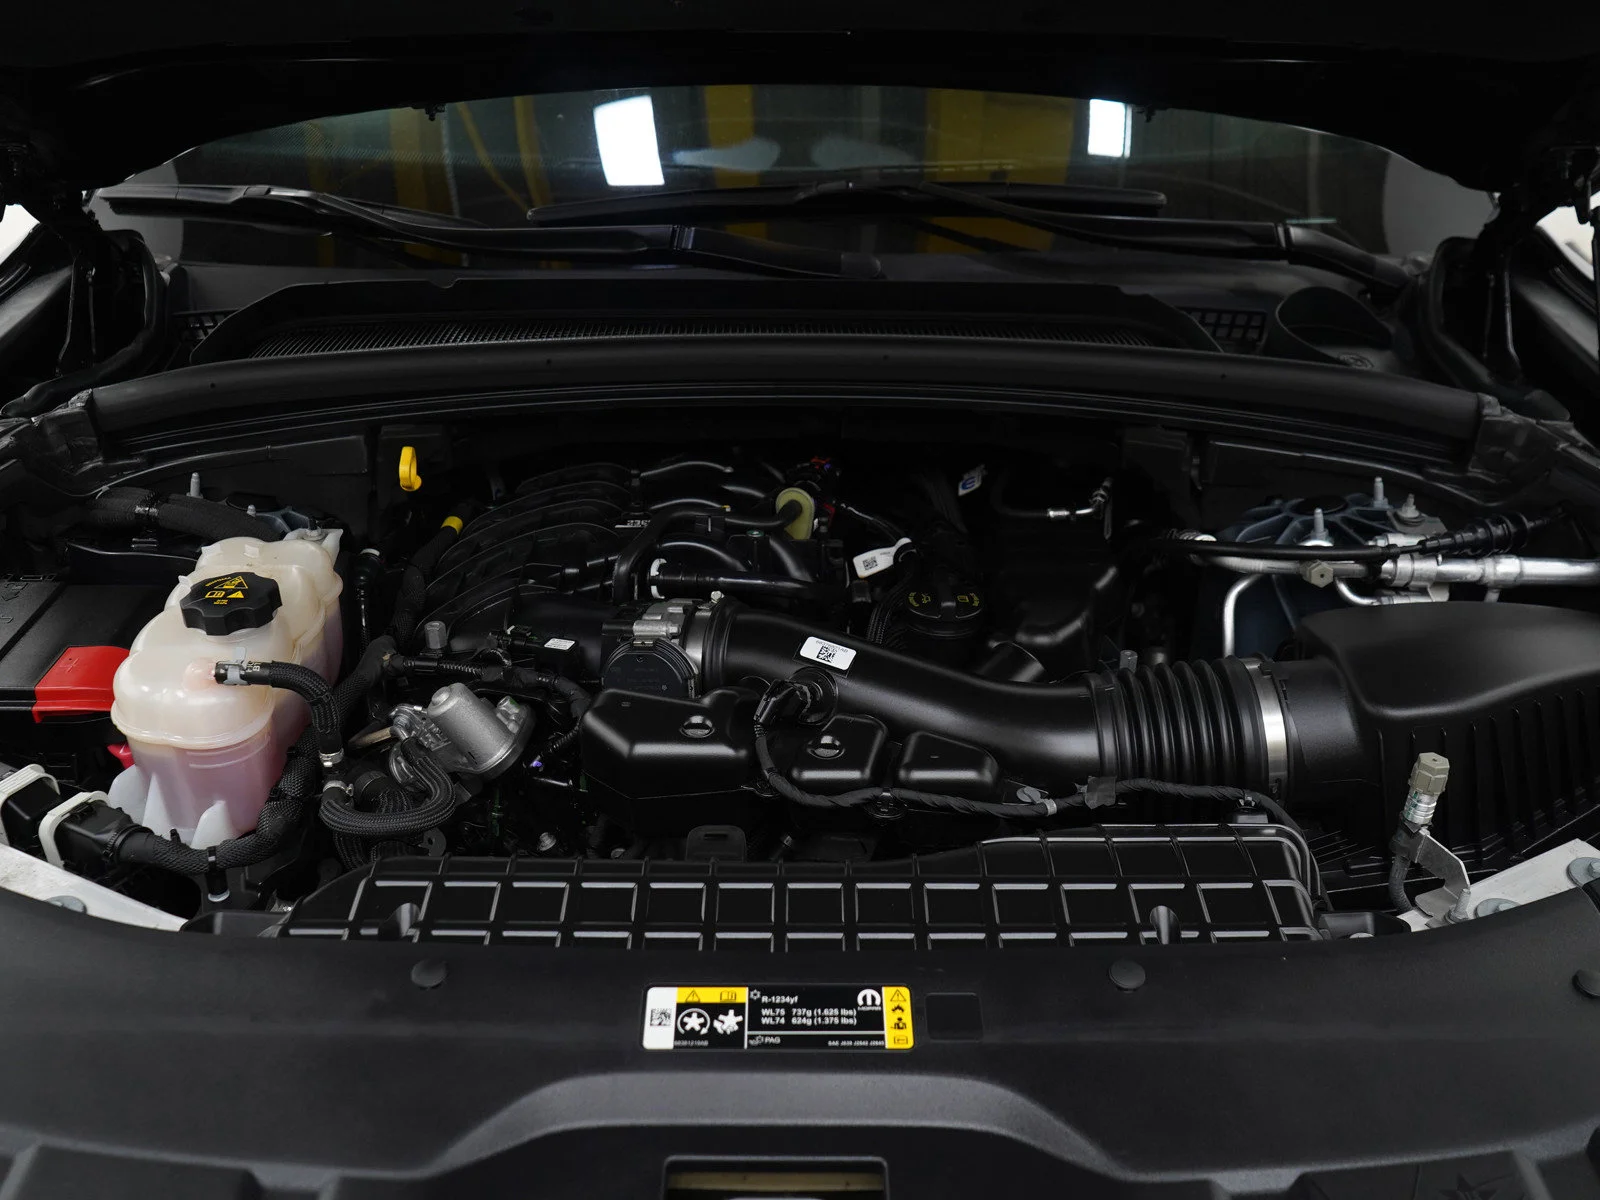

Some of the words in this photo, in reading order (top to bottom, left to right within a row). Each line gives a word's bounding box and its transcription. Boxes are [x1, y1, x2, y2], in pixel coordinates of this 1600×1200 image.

[761, 995, 798, 1005] R-1234yf
[761, 1008, 785, 1016] WL75
[791, 1008, 812, 1017] 737g
[813, 1008, 839, 1017] (1.625
[840, 1008, 857, 1017] lbs)
[761, 1016, 785, 1024] WL74
[791, 1016, 812, 1026] 624g
[813, 1016, 839, 1026] (1.375
[840, 1016, 857, 1026] lbs)
[764, 1036, 781, 1045] PAG
